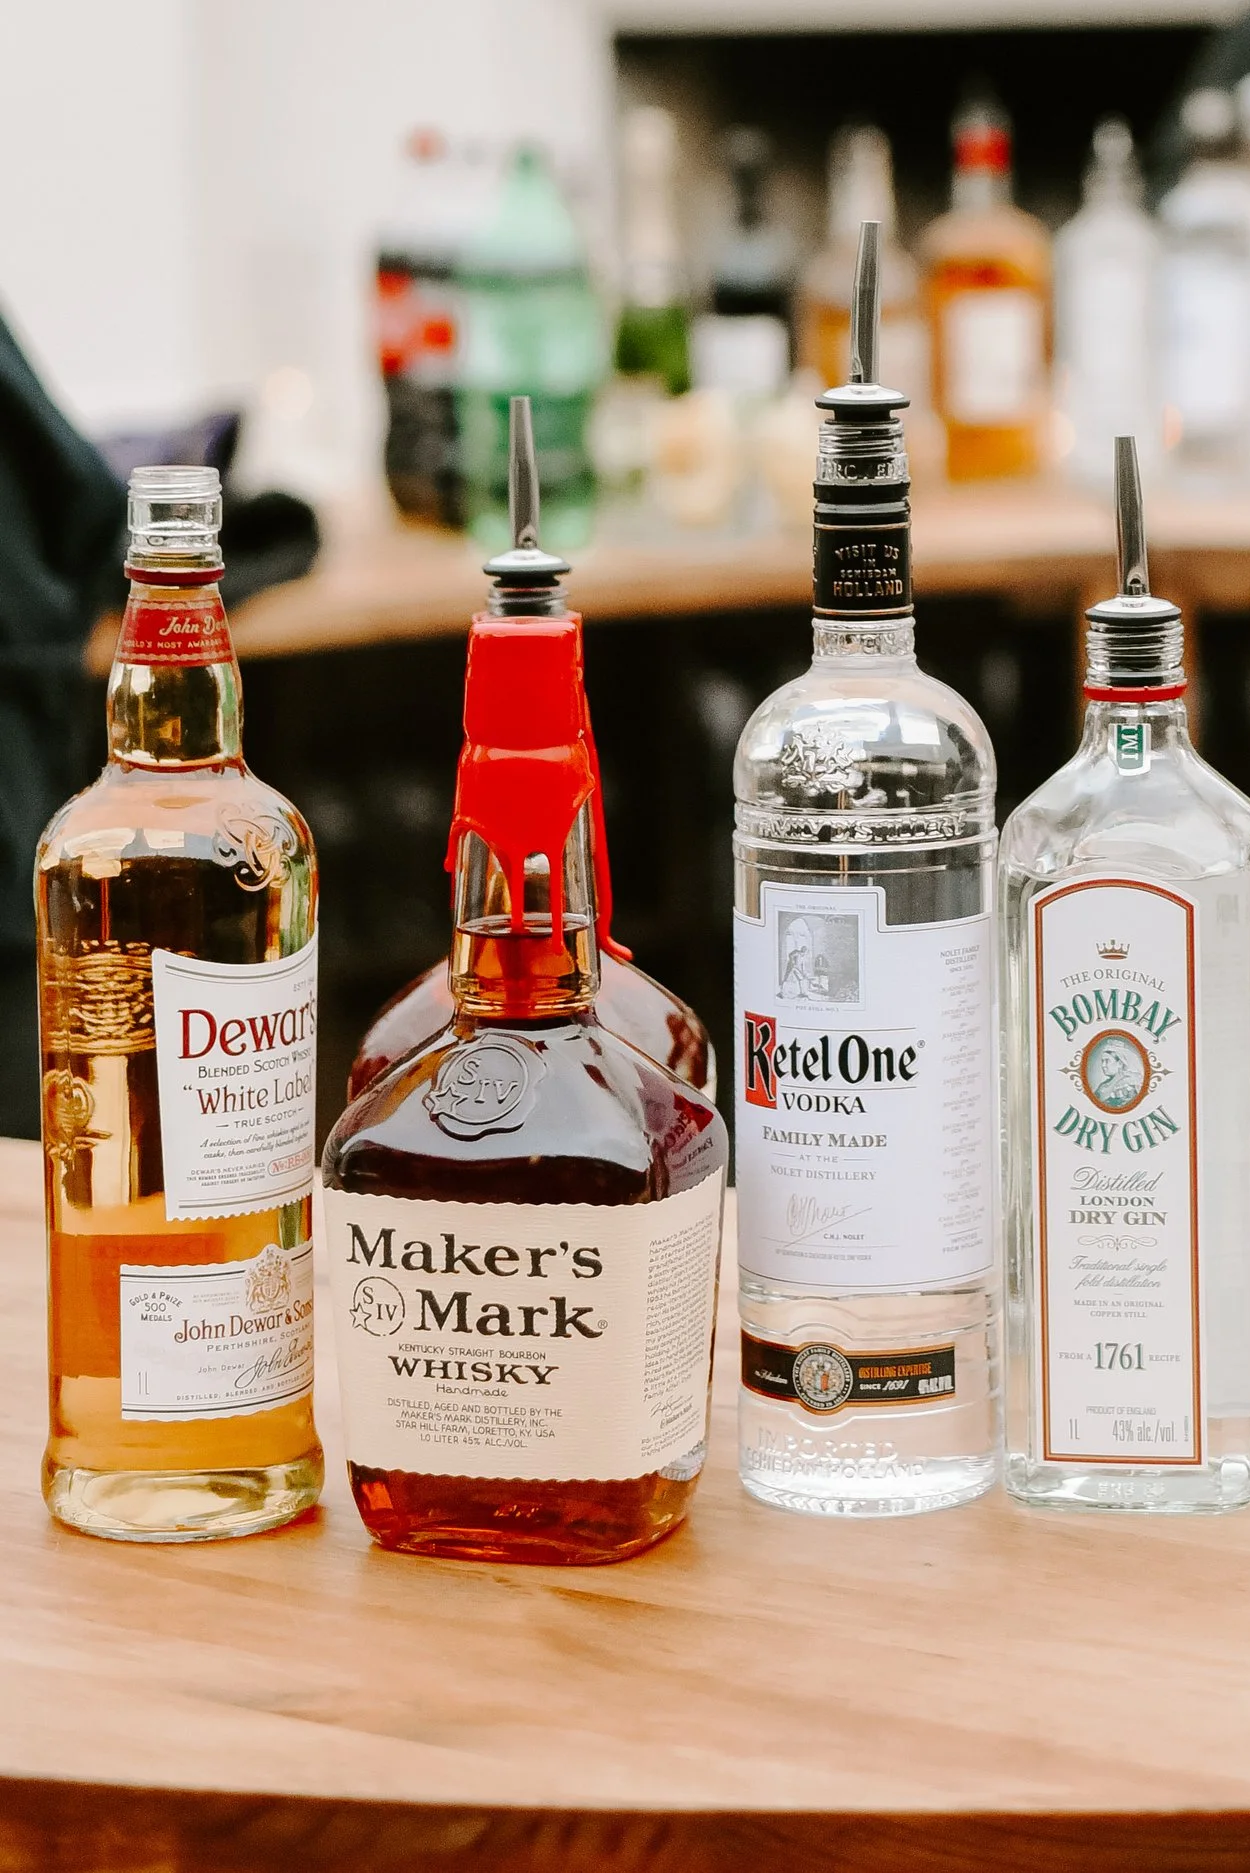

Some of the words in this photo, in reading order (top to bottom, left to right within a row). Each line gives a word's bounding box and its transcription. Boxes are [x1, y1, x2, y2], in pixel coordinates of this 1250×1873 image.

[834, 544, 877, 561] VISIT
[884, 544, 900, 560] US
[832, 580, 904, 597] HOLLAND
[1060, 971, 1091, 989] THE
[1093, 968, 1166, 993] ORIGINAL
[177, 989, 318, 1060] Dewar's
[1048, 988, 1182, 1044] BOMBAY
[745, 1019, 833, 1101] Ketel
[837, 1033, 919, 1084] One
[781, 1091, 867, 1116] VODKA
[233, 1116, 263, 1129] TRUE
[264, 1107, 297, 1125] SCOTCH
[762, 1125, 824, 1147] FAMILY
[827, 1132, 888, 1148] MADE
[1053, 1103, 1119, 1155] DRY
[1121, 1104, 1182, 1154] GIN
[799, 1154, 811, 1163] AT
[816, 1155, 839, 1164] THE
[770, 1164, 802, 1178] NOLET
[806, 1168, 877, 1181] DISTILLERY
[1070, 1166, 1164, 1193] Distilled
[1079, 1195, 1156, 1207] LONDON
[1068, 1209, 1118, 1226] DRY
[1122, 1210, 1169, 1227] GIN
[346, 1222, 604, 1280] Maker's
[1068, 1254, 1133, 1272] Traditional
[1134, 1257, 1168, 1277] single
[1074, 1274, 1102, 1291] fold
[1102, 1275, 1162, 1289] distillation
[129, 1292, 150, 1307] GOLD
[159, 1290, 184, 1309] PRIZE
[361, 1286, 375, 1305] S
[1073, 1298, 1097, 1308] MADE
[1099, 1299, 1108, 1308] IN
[1110, 1299, 1121, 1308] AN
[1124, 1300, 1165, 1309] ORIGINAL
[144, 1302, 167, 1312] 500
[375, 1302, 398, 1322] IV
[413, 1288, 605, 1339] Mark
[1089, 1309, 1122, 1319] COPPER
[1123, 1310, 1148, 1319] STILL
[140, 1313, 173, 1322] MEDALS
[173, 1318, 226, 1344] John
[229, 1311, 284, 1338] Dewar
[284, 1309, 293, 1325] &
[398, 1343, 445, 1355] KENTUCKY
[448, 1346, 494, 1358] STRAIGHT
[499, 1349, 546, 1361] BOURBON
[1058, 1350, 1085, 1361] FROM
[1093, 1341, 1147, 1371] 1761
[1148, 1353, 1181, 1364] RECIPE
[198, 1364, 216, 1374] John
[388, 1355, 560, 1385] WHISKY
[436, 1383, 509, 1398] Handmade
[859, 1382, 881, 1391] SINCE
[387, 1397, 433, 1412] DISTILLED,
[434, 1402, 459, 1413] AGED
[461, 1404, 481, 1414] AND
[484, 1405, 527, 1417] BOTTLED
[529, 1407, 542, 1417] BY
[544, 1408, 563, 1418] THE
[400, 1410, 442, 1423] MAKER'S
[443, 1413, 473, 1424] MARK
[474, 1415, 528, 1428] DISTILLERY,
[529, 1419, 549, 1428] INC.
[395, 1419, 418, 1430] STAR
[419, 1421, 439, 1432] HILL
[441, 1423, 471, 1435] FARM,
[472, 1426, 518, 1439] LORETTO,
[535, 1429, 556, 1439] USA
[1112, 1418, 1134, 1442] 43%
[434, 1435, 460, 1445] LITER
[463, 1437, 481, 1446] 45%
